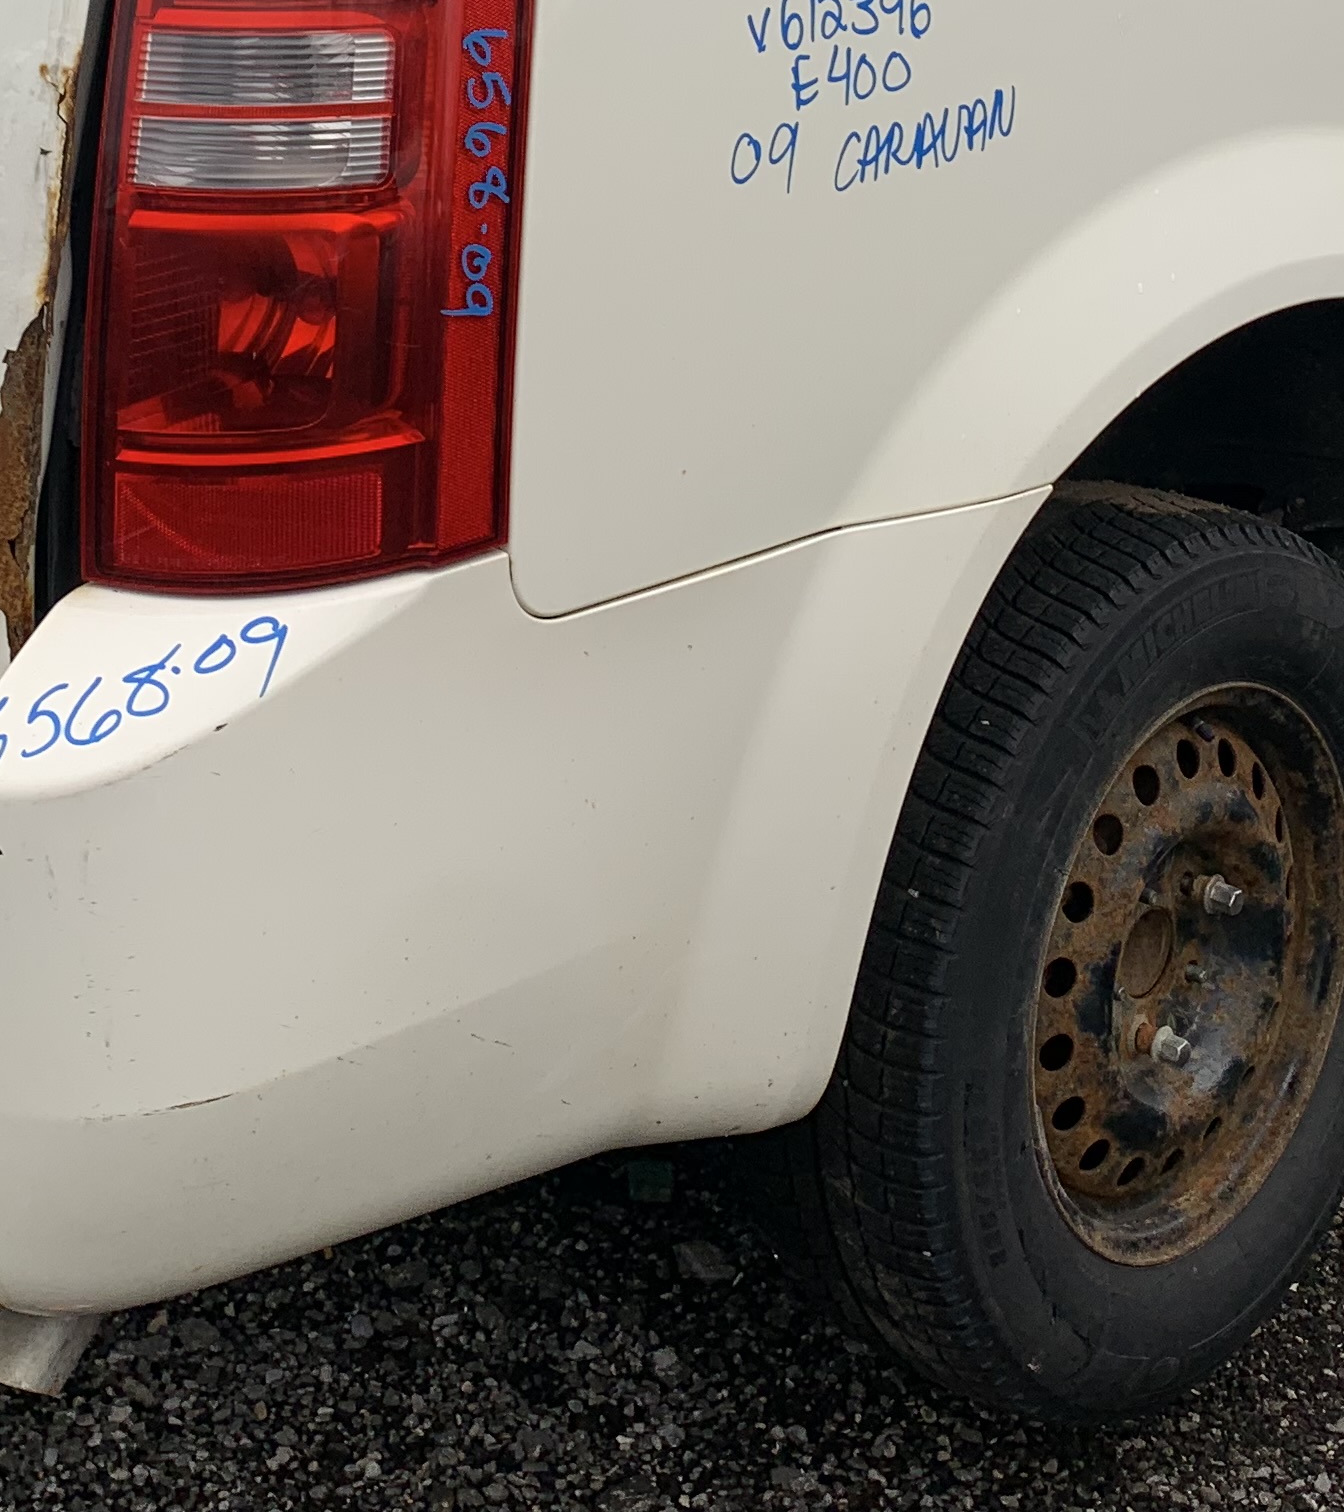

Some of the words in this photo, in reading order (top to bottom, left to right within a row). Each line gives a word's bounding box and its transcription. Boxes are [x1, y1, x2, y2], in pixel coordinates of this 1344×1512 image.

[790, 44, 912, 110] E400
[730, 121, 800, 194] 09
[834, 85, 1016, 192] CARAVAN
